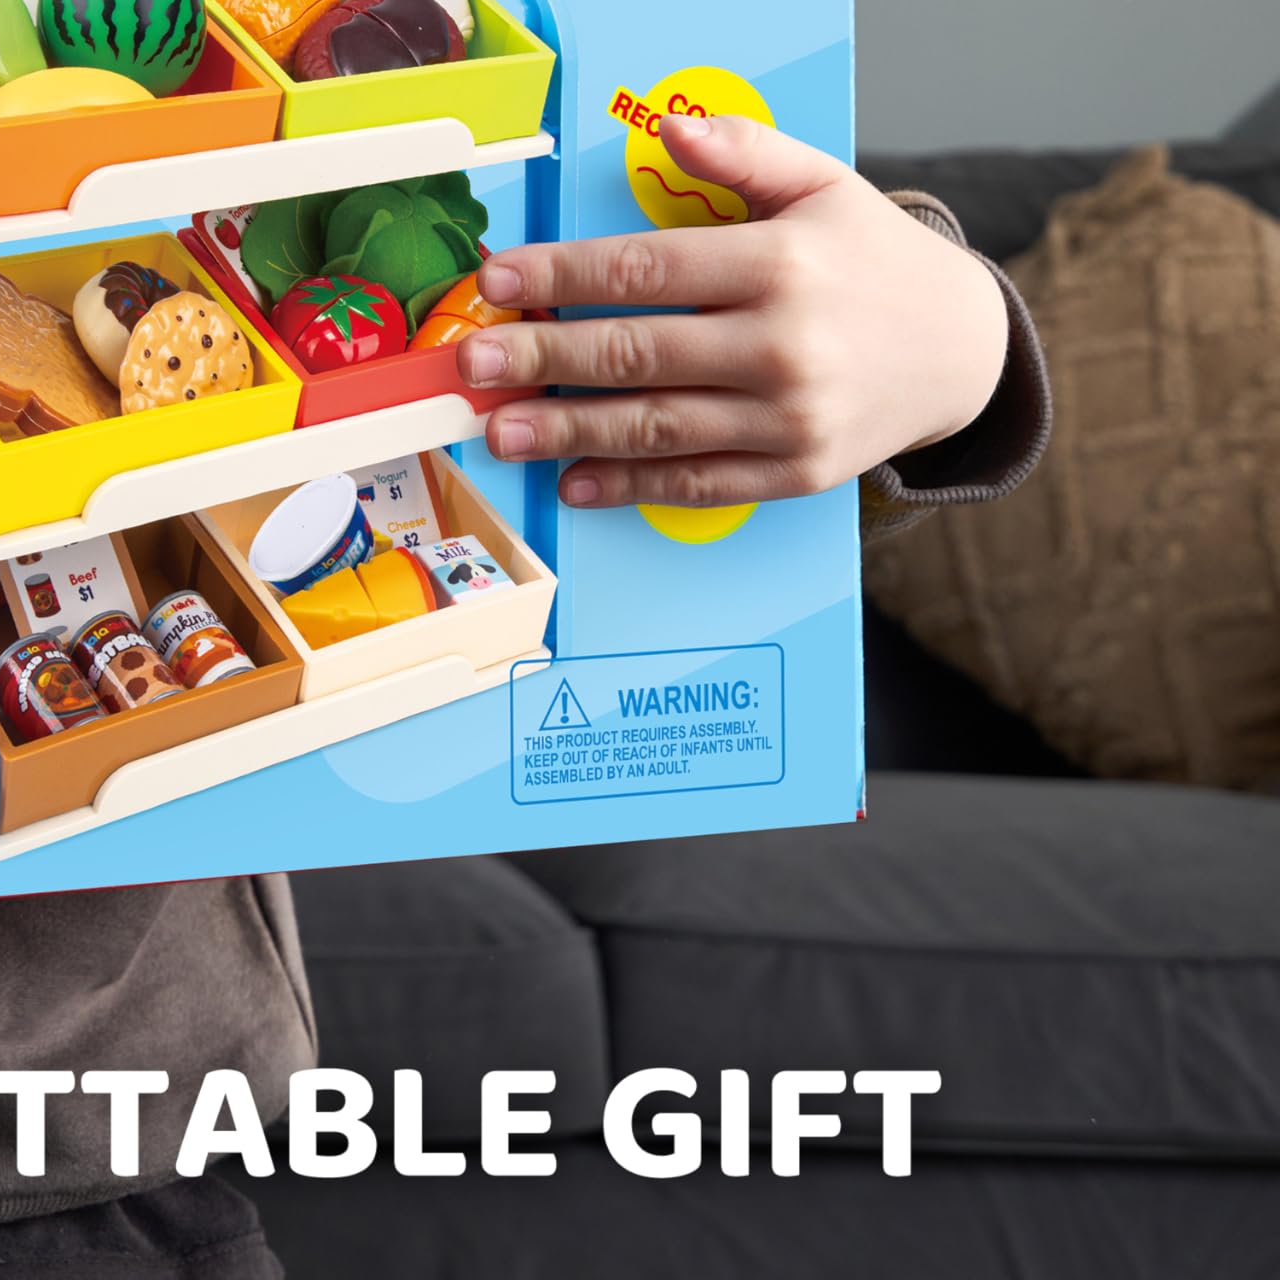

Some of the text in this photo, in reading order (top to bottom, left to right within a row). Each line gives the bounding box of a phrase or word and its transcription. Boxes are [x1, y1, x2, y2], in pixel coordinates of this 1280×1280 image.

[374, 469, 408, 486] Yogurt
[389, 484, 403, 501] $1
[387, 517, 428, 534] Cheese
[403, 532, 421, 549] $2
[435, 546, 472, 562] Milk
[68, 567, 97, 586] Beef
[78, 585, 95, 603] $1
[158, 613, 206, 657] umpkin
[618, 680, 760, 718] WARNING:
[524, 720, 759, 751] THIS PRODUCT REQUIRES ASSEMBLY.
[524, 736, 773, 769] KEEP OUT OF REACH OF INFANTS UNTIL
[524, 760, 692, 787] ASSEMBLED BY AN ADULT.
